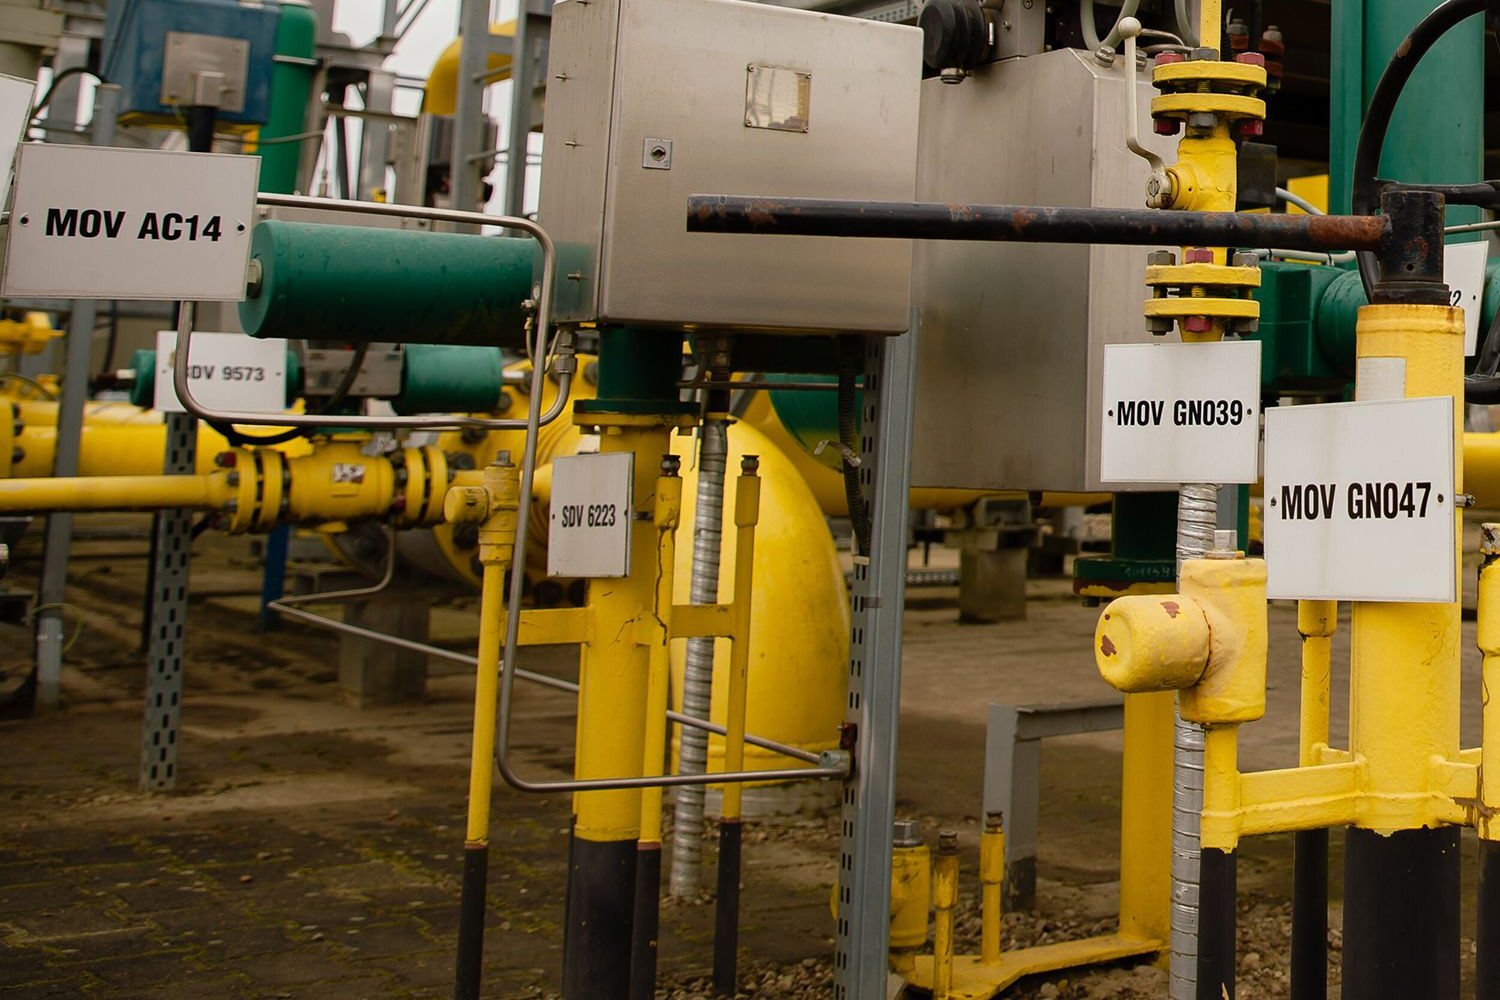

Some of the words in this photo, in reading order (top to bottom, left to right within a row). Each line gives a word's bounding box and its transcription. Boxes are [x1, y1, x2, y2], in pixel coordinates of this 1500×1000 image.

[45, 208, 126, 239] MOV
[137, 212, 222, 242] AC14
[222, 365, 264, 382] 9573
[1117, 400, 1164, 426] MOV
[1281, 484, 1336, 520] MOV
[562, 504, 584, 528] SDV
[587, 503, 616, 528] 6223
